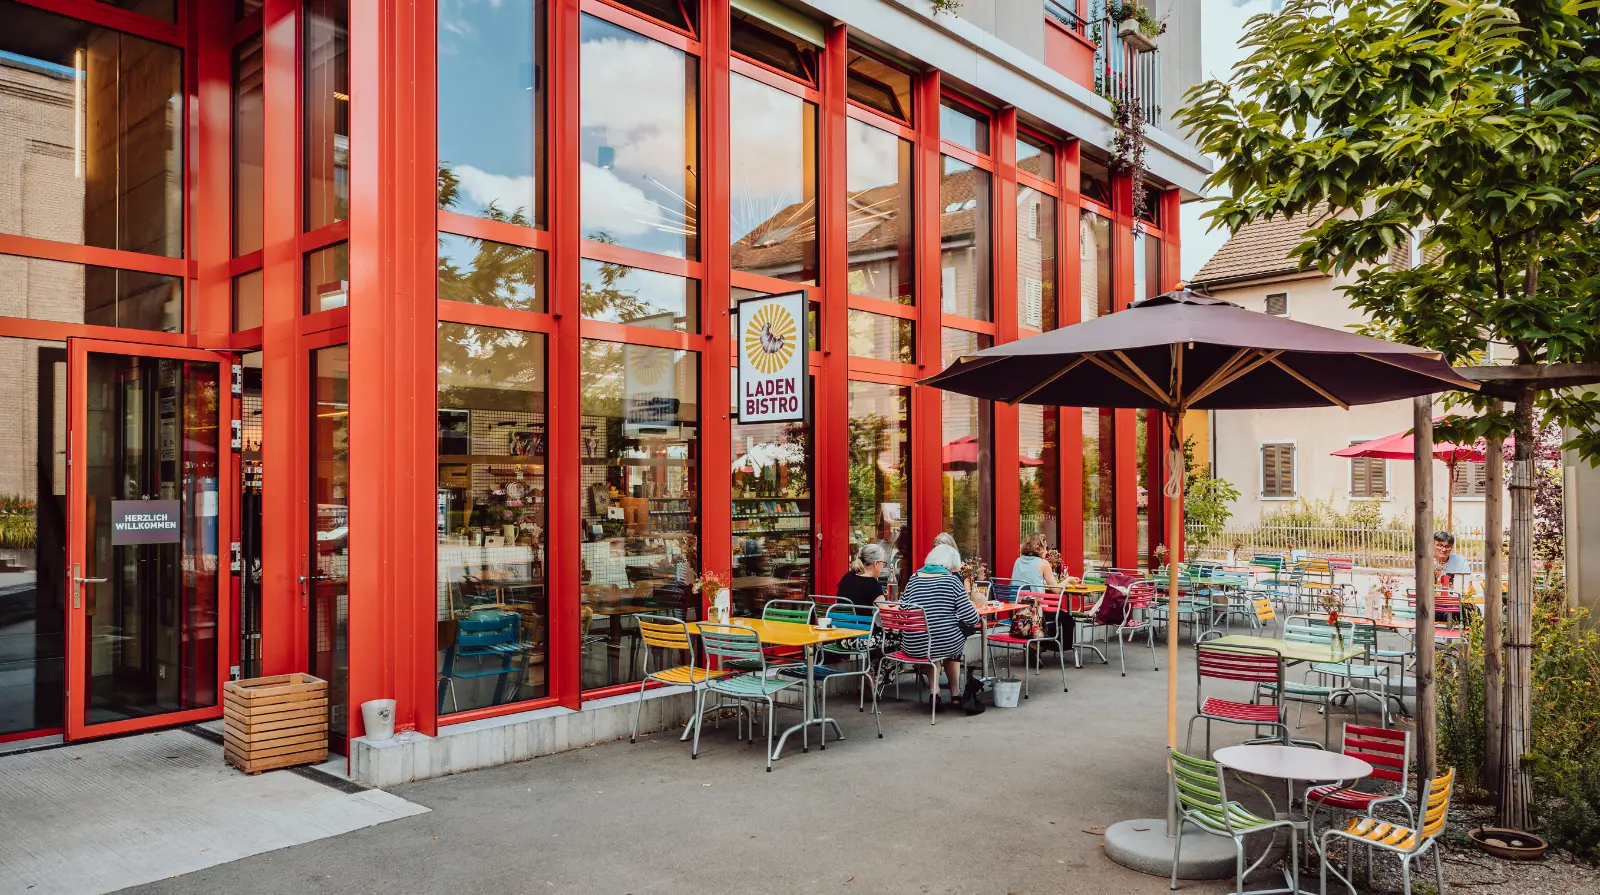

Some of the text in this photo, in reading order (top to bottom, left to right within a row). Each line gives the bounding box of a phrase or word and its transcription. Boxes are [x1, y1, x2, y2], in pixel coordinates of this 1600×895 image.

[746, 378, 795, 397] LADEN
[746, 396, 798, 415] BISTRO
[115, 522, 177, 530] WILLKOMMEN
